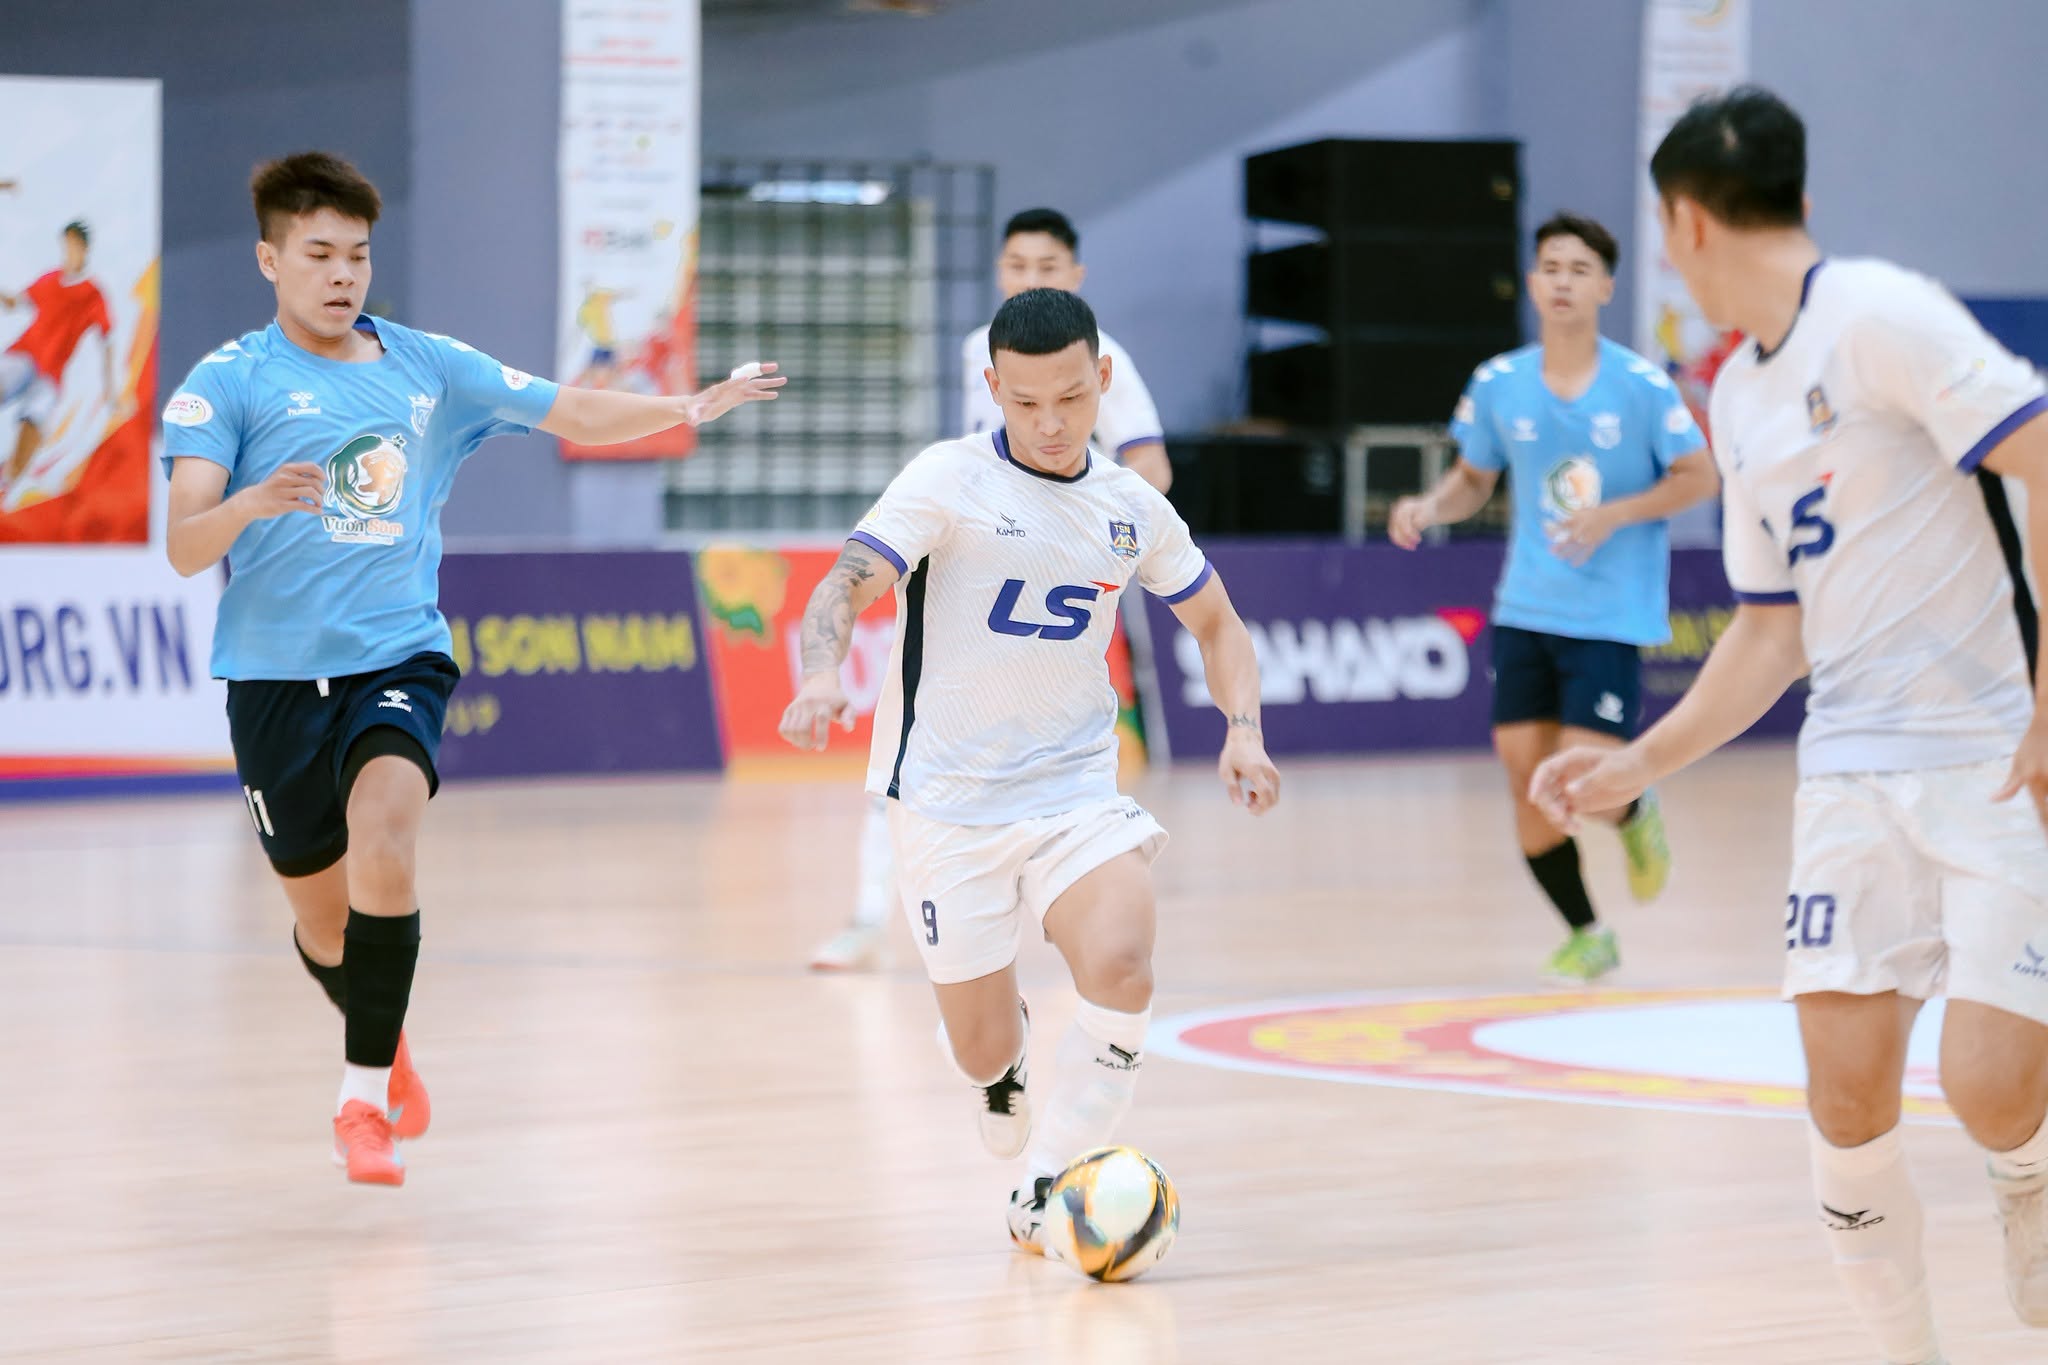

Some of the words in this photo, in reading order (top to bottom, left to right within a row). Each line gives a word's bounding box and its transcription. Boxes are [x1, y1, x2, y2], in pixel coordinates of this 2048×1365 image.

[996, 527, 1026, 538] KAMITO
[988, 579, 1099, 641] LS
[243, 784, 275, 837] 11
[921, 900, 939, 946] 9
[1785, 893, 1836, 949] 20
